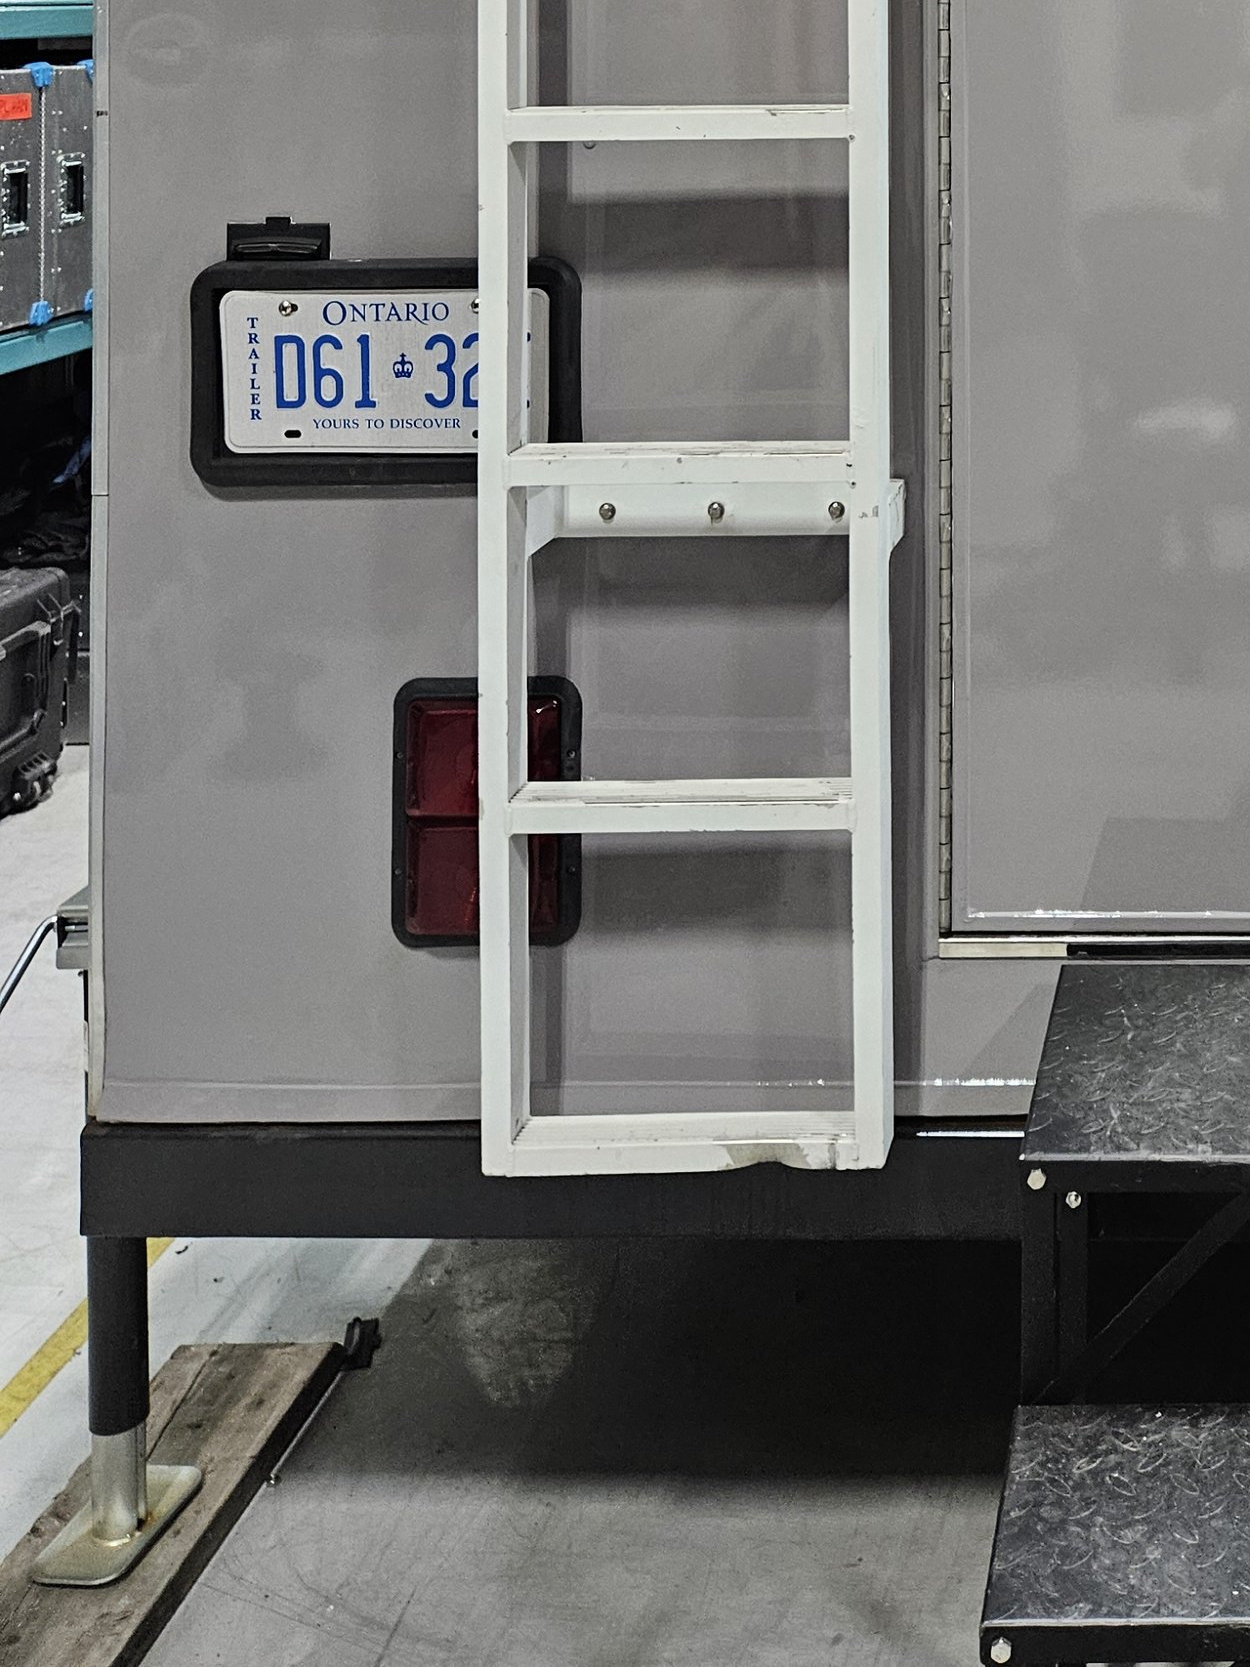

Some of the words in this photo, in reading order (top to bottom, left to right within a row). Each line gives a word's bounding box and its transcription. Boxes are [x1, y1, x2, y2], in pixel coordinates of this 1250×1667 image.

[323, 300, 450, 326] ONTARIO
[247, 317, 262, 421] TRAILER
[274, 334, 377, 409] D61
[313, 418, 360, 430] YOURS
[365, 418, 384, 429] TO
[390, 417, 462, 430] DISCOVER
